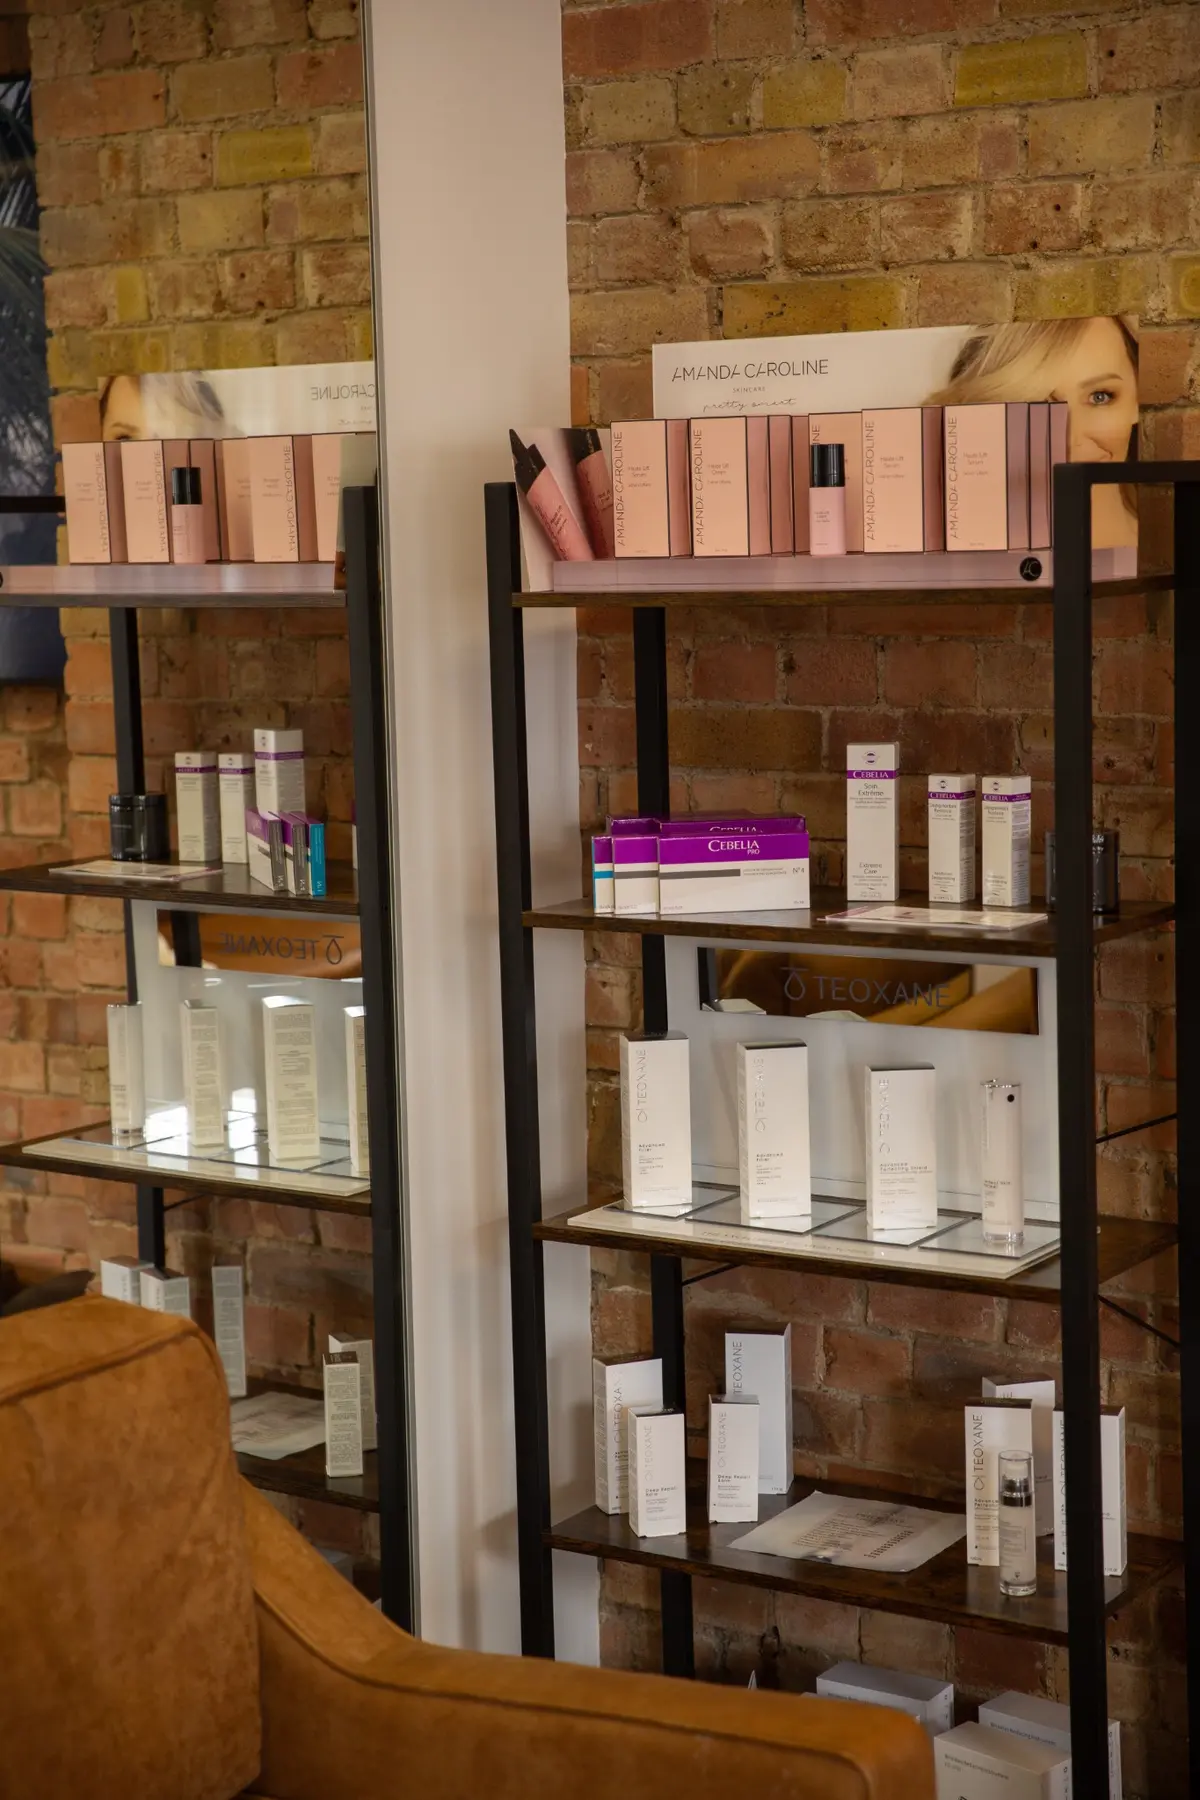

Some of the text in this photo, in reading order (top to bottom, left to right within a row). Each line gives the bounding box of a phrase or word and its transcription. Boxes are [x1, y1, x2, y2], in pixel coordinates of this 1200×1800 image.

[672, 359, 829, 382] AMANDA CAROLINE
[732, 386, 766, 394] SKINCARE
[613, 431, 626, 547] AMANDA CAROLINE
[693, 429, 704, 546] AMANDA CAROLINE
[864, 420, 876, 541] AMANDA CAROLINE
[948, 416, 959, 539] AMANDA CAROLINE
[852, 770, 889, 779] CEBELIA
[812, 975, 950, 1009] TEOXANE
[636, 1049, 647, 1106] TEOXANE
[732, 1340, 743, 1394] TEOXANE
[973, 1414, 984, 1472] TEOXANE
